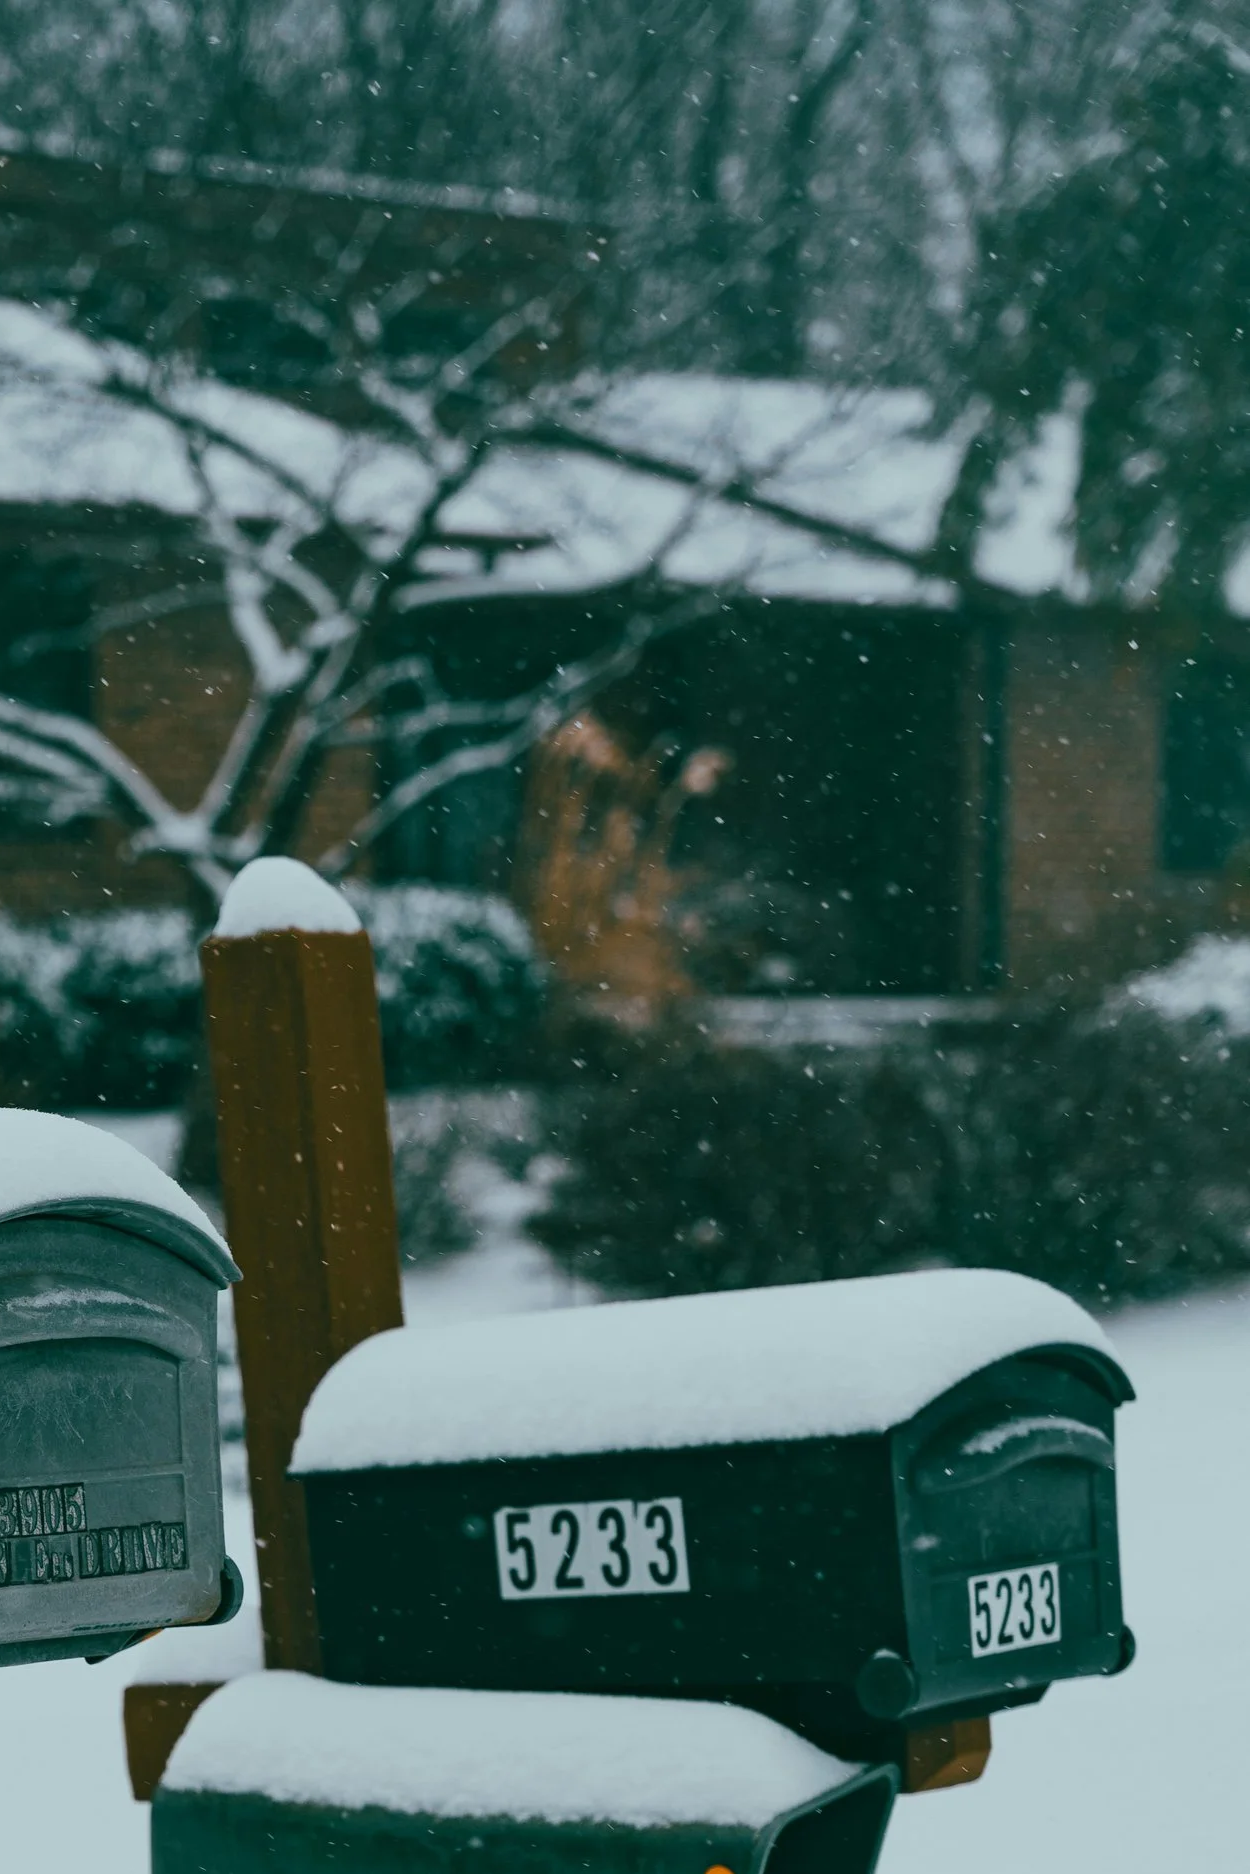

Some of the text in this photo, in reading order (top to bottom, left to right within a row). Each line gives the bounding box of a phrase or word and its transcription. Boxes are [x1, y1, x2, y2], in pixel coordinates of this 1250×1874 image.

[78, 1523, 187, 1579] DRIVE
[506, 1505, 678, 1591] 5233
[974, 1569, 1056, 1649] 5233
